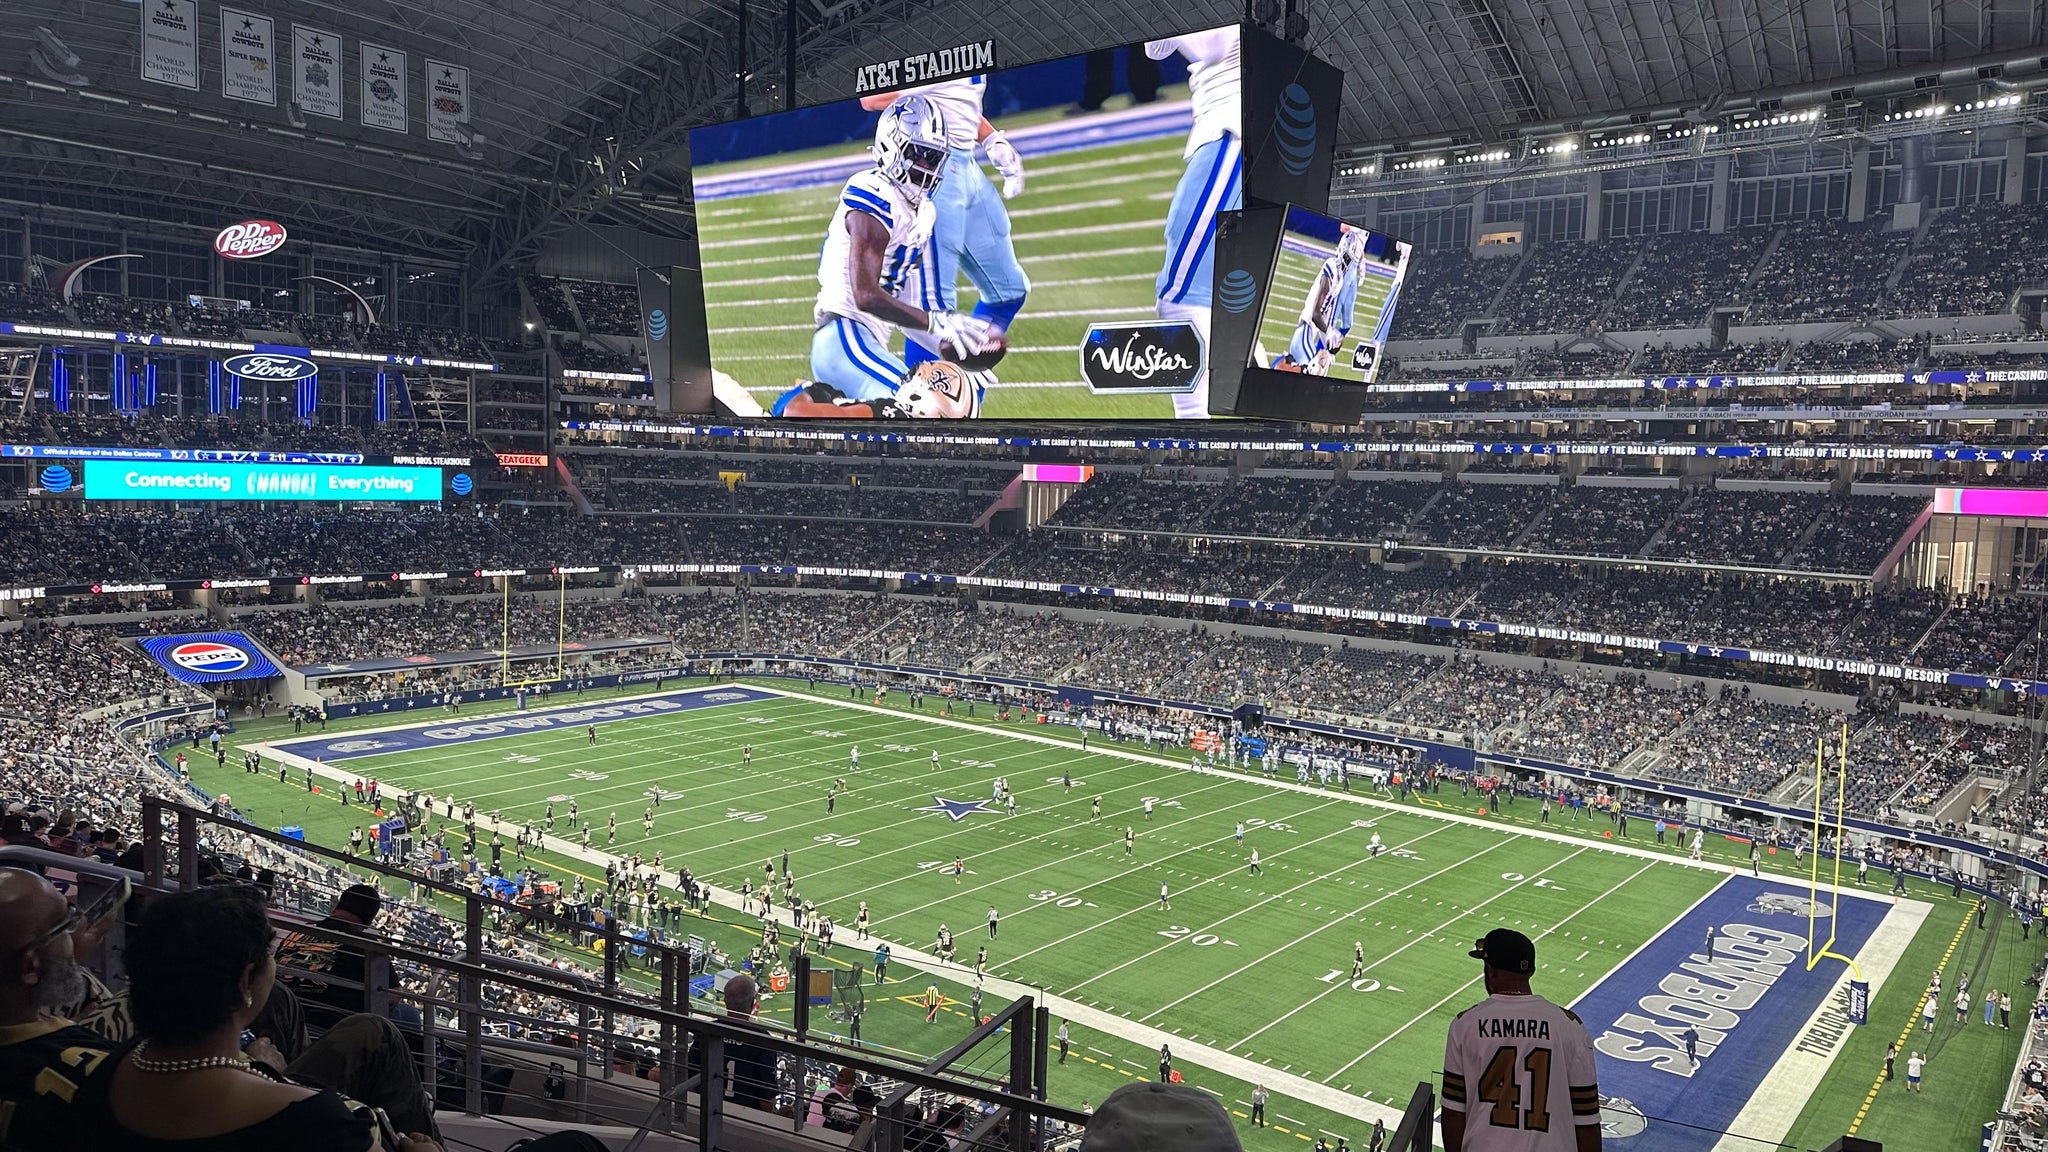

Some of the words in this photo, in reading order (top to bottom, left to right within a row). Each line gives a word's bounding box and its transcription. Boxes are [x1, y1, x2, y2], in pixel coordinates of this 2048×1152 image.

[156, 11, 183, 23] DALLAS
[153, 18, 187, 30] COWBOYS
[235, 30, 261, 41] DALLAS
[232, 36, 264, 49] COWBOYS
[228, 50, 248, 60] SUPER
[250, 55, 268, 64] BOWL
[302, 52, 332, 64] COWBOYS
[305, 46, 329, 57] DALLAS
[155, 54, 185, 67] WORLD
[856, 60, 900, 93] AT&T
[904, 40, 994, 83] STADIUM
[146, 61, 194, 77] CHAMPIONS
[370, 69, 398, 80] COWBOYS
[372, 63, 395, 73] DALLAS
[235, 73, 263, 84] WORLD
[437, 80, 458, 88] DALLAS
[228, 79, 272, 94] CHAMPIONS
[305, 87, 331, 99] WORLD
[434, 85, 461, 96] COWBOYS
[297, 93, 338, 107] CHAMPIONS
[373, 102, 397, 113] WORLD
[365, 108, 404, 122] CHAMPIONS
[244, 223, 271, 239] Dr
[217, 225, 282, 254] Pepper
[1091, 337, 1192, 379] WinStar
[241, 356, 302, 377] Ford
[1612, 446, 1625, 454] THE
[1627, 446, 1656, 454] DALLAS
[1658, 446, 1696, 455] COWBOYS
[1767, 448, 1781, 456] THE
[1784, 448, 1814, 456] CASINO
[1816, 448, 1826, 457] OF
[1831, 448, 1846, 457] THE
[1850, 449, 1884, 458] DALLAS
[1887, 449, 1932, 458] COWBOYS
[394, 456, 415, 464] PAPPAS
[433, 457, 471, 466] STEAKHOUSE
[499, 455, 541, 464] SEATGEEK
[125, 471, 231, 492] Connecting
[328, 475, 413, 492] Everything
[310, 575, 362, 584] Blockchain.com
[400, 571, 448, 580] Blockchain.com
[102, 584, 166, 593] Blockchain.com
[211, 579, 269, 588] Blockchain.com
[0, 590, 11, 600] NO
[13, 589, 32, 599] AND
[33, 587, 45, 598] RE
[1114, 588, 1141, 598] WINSTAR
[1143, 591, 1164, 600] WORLD
[1166, 593, 1189, 602] CASINO
[1190, 595, 1204, 604] AND
[1205, 596, 1230, 606] RESORT
[1293, 604, 1323, 615] WINSTAR
[1325, 607, 1350, 618] WORLD
[1352, 609, 1378, 621] CASINO
[1380, 612, 1396, 622] AND
[1398, 614, 1427, 625] RESORT
[1499, 624, 1536, 637] WINSTAR
[1538, 628, 1568, 640] WORLD
[1570, 631, 1602, 644] CASINO
[1604, 634, 1622, 646] AND
[1625, 636, 1660, 650] RESORT
[179, 652, 241, 663] PEPSI
[1750, 650, 1794, 666] WINSTAR
[1797, 655, 1833, 671] WORLD
[1836, 659, 1875, 676] CASINO
[1879, 664, 1901, 679] AND
[1905, 667, 1948, 684] RESORT
[422, 700, 682, 739] COWBOYS
[813, 833, 860, 846] 50
[917, 861, 963, 875] 40
[1028, 889, 1082, 907] 30
[1157, 926, 1219, 946] 20
[777, 979, 784, 987] G
[1314, 968, 1381, 992] 10
[1594, 923, 1808, 1078] COWBOYS
[1478, 1018, 1550, 1040] KAMARA
[1478, 1045, 1552, 1133] 41
